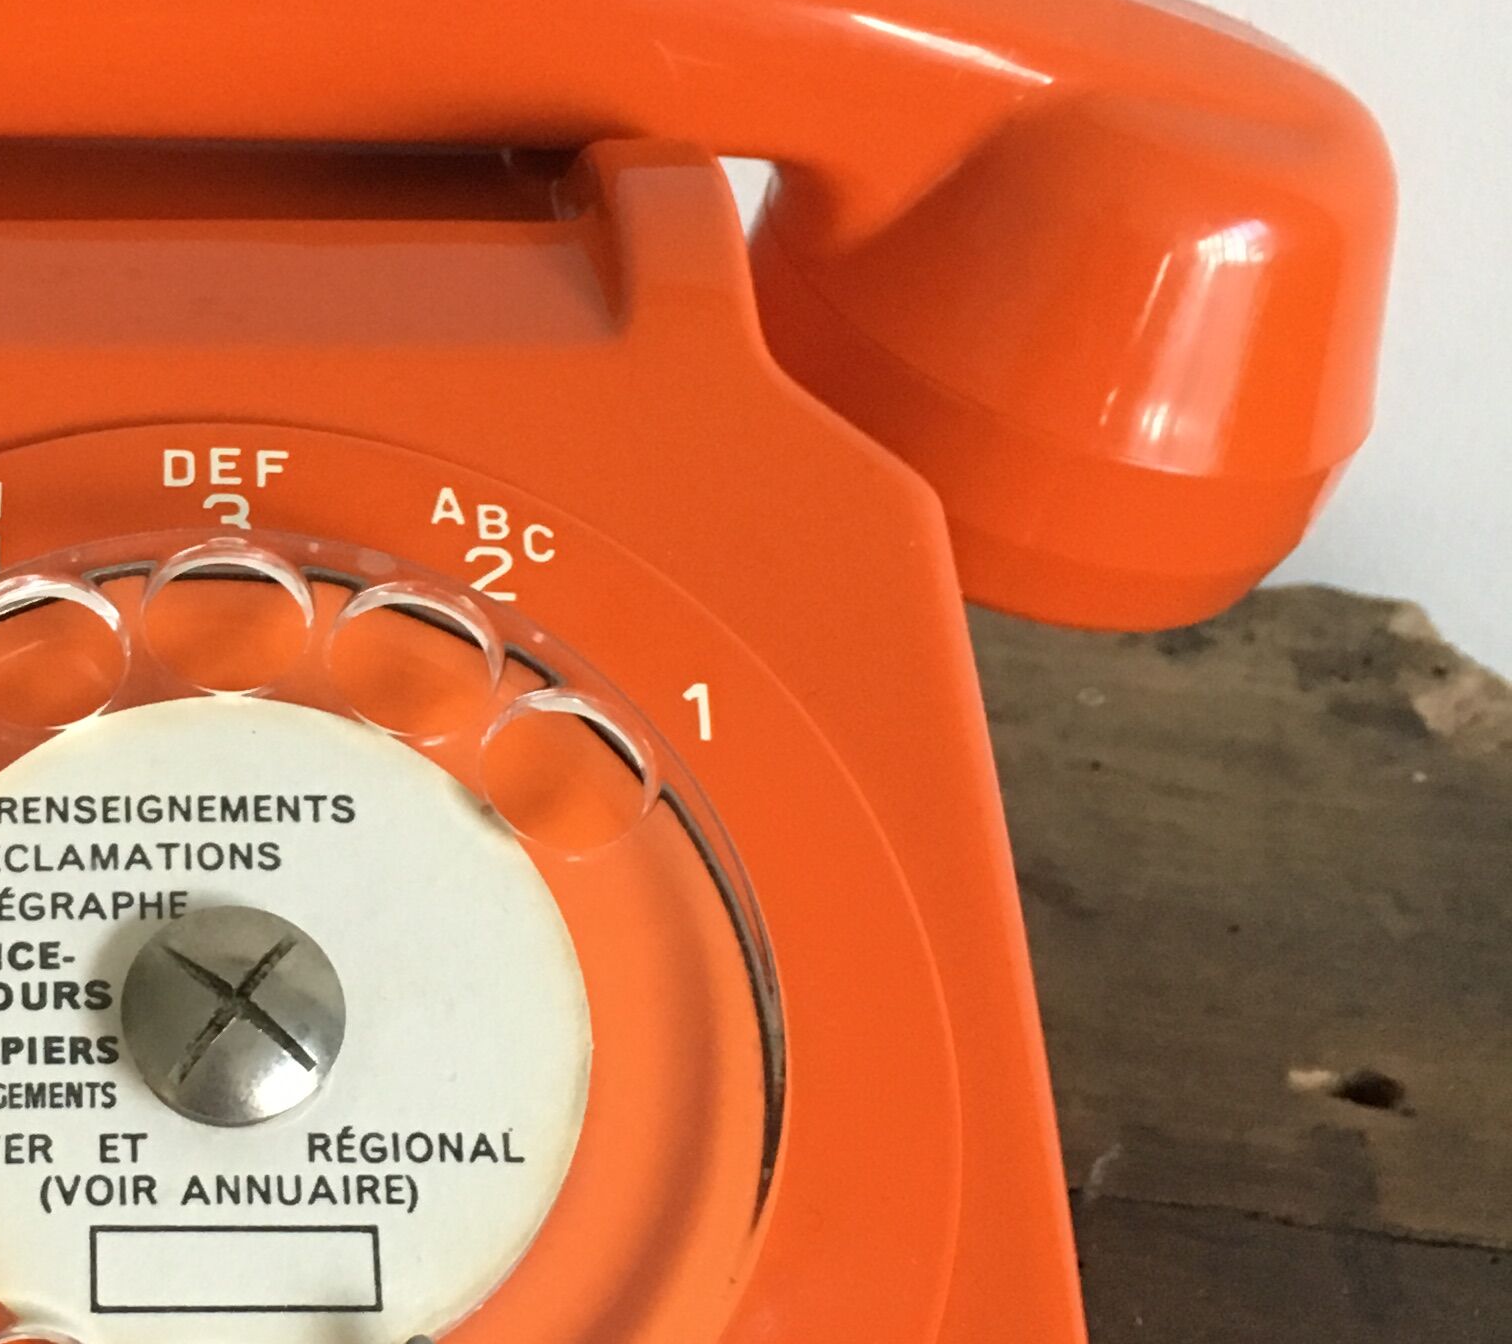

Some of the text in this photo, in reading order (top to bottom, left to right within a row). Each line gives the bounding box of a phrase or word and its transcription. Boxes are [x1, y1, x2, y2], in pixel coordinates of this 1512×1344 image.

[163, 447, 290, 488] DEF
[202, 492, 252, 531] 3
[431, 487, 556, 563] ABC
[464, 545, 518, 602] 2
[681, 681, 713, 742] 1
[98, 1132, 149, 1165] ET
[306, 1125, 526, 1164] RÉGIONAL
[39, 1173, 421, 1214] (VOIR ANNUAIRE)
